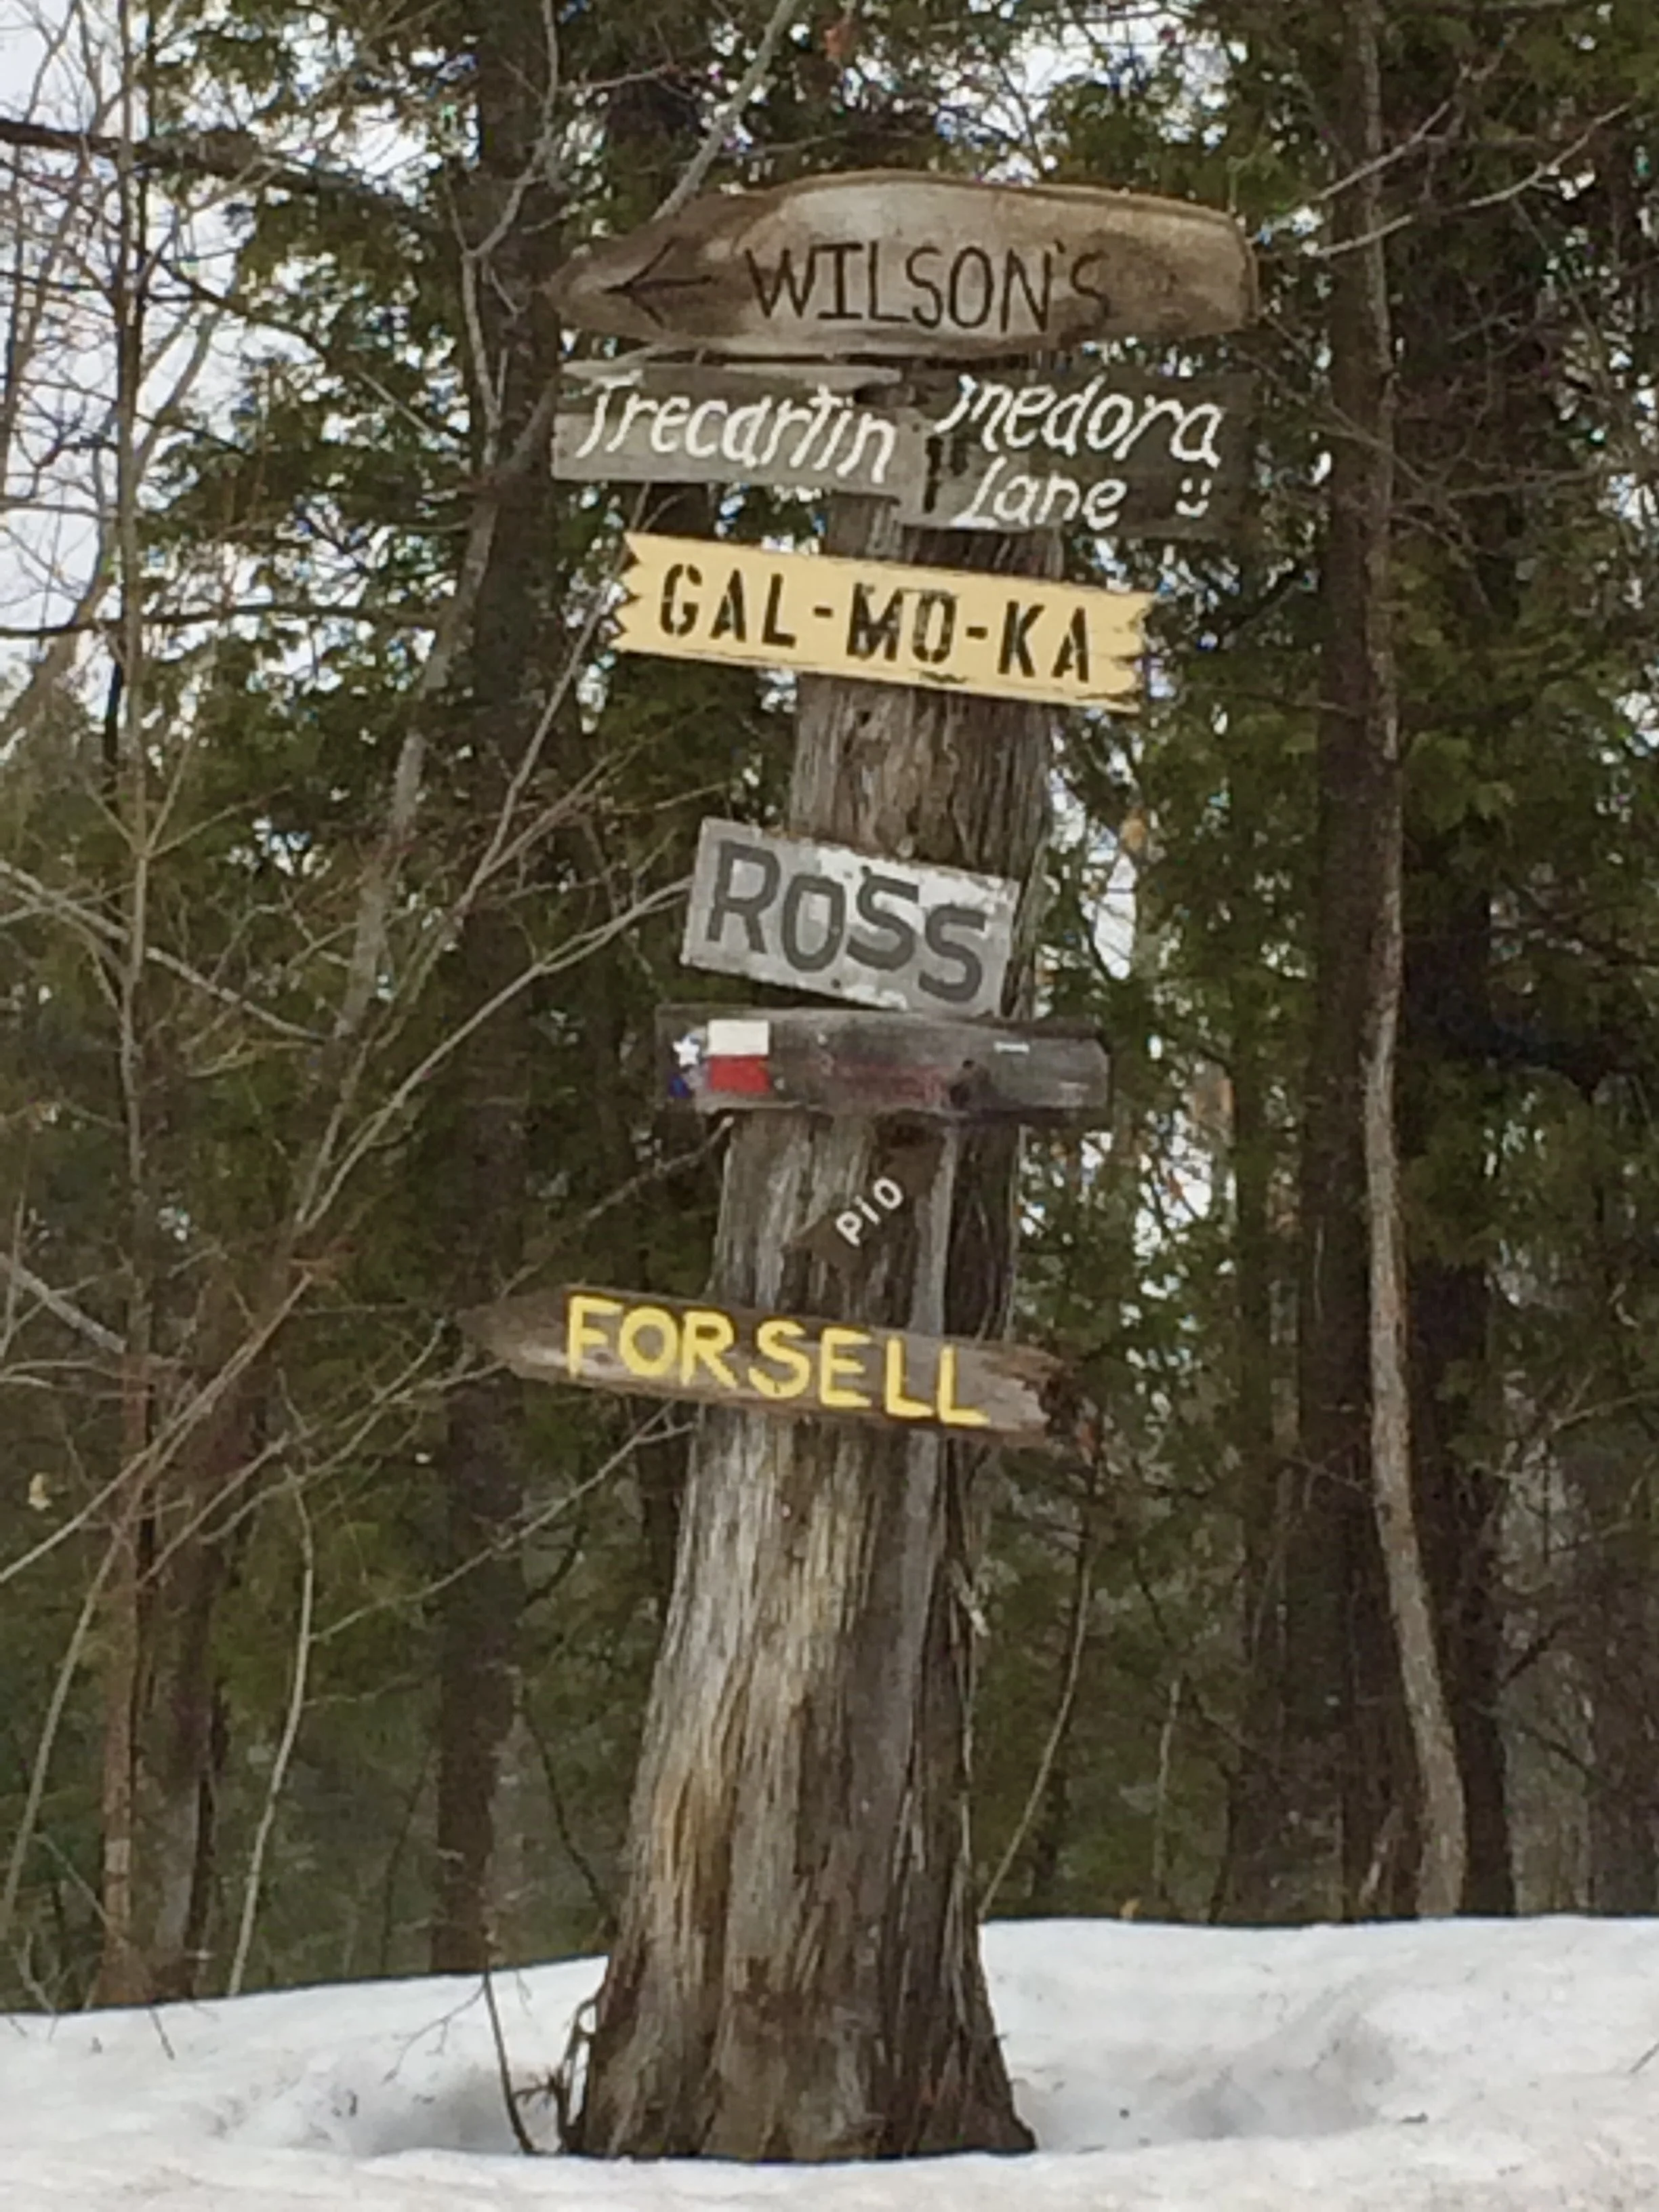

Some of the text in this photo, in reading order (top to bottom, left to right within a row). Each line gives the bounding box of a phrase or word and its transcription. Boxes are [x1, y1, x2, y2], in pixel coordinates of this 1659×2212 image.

[745, 239, 1111, 334] WILSON'S
[575, 368, 897, 483] Trecartin
[659, 563, 1089, 682] GAL-MO-KA
[705, 839, 986, 1005] ROSS
[567, 1295, 990, 1427] FORSELL
